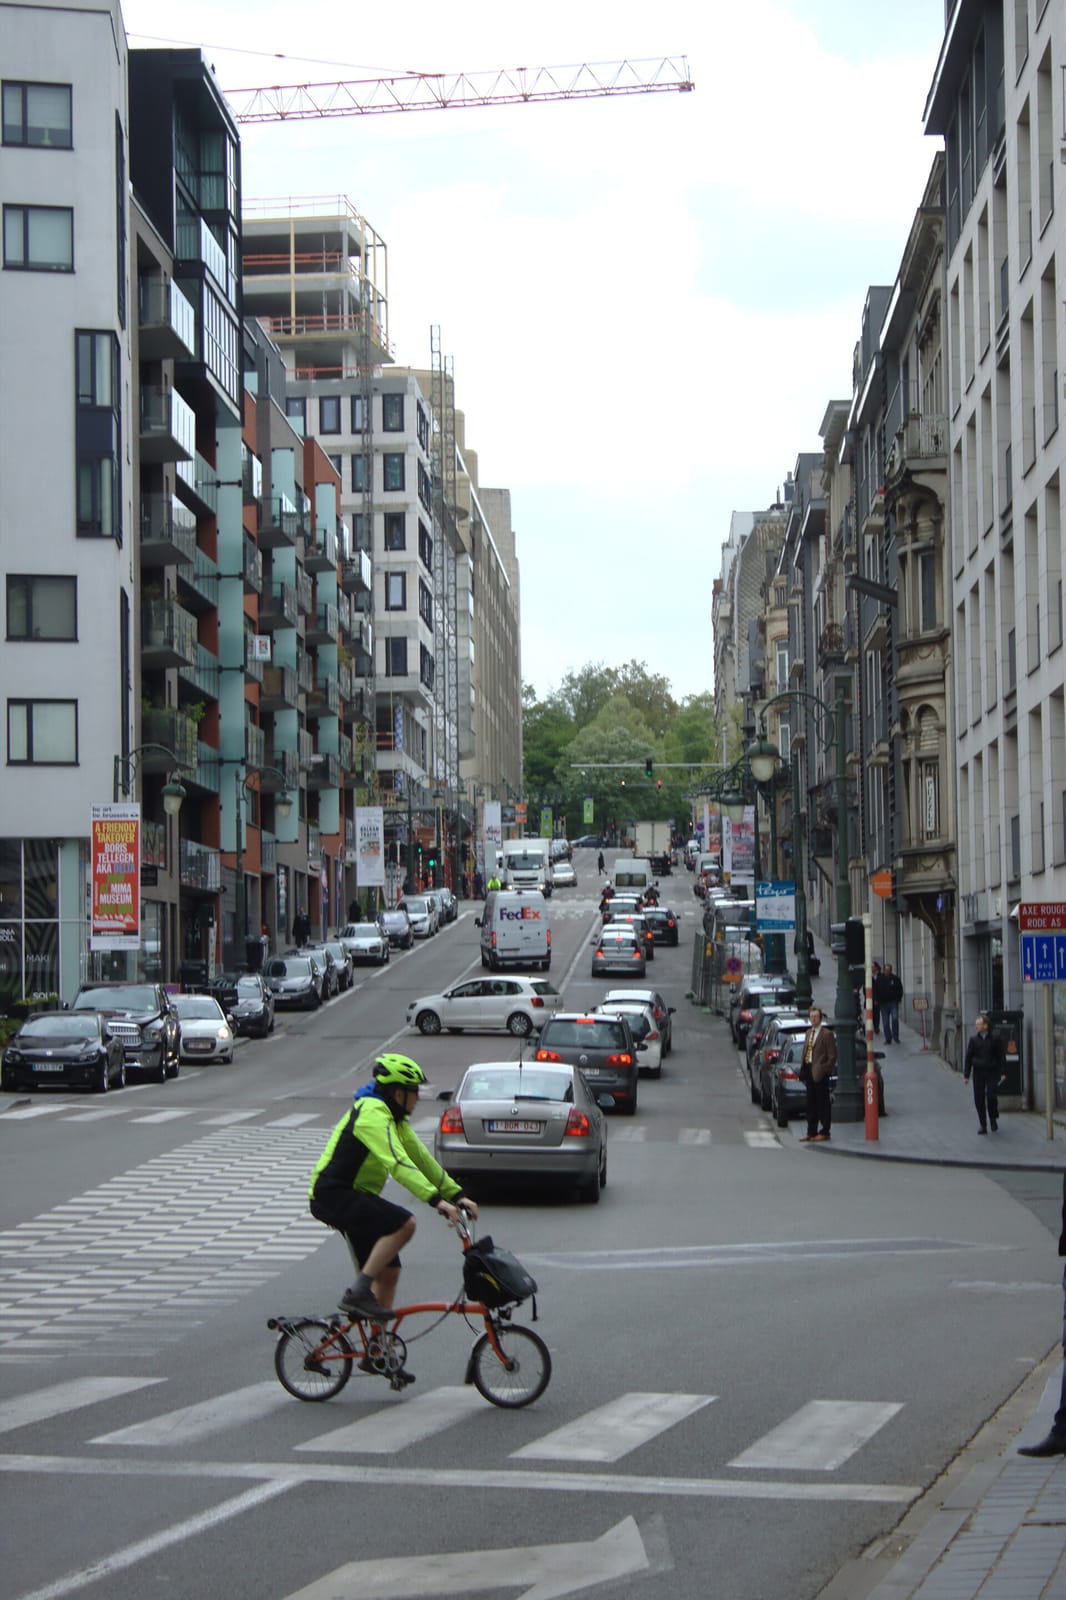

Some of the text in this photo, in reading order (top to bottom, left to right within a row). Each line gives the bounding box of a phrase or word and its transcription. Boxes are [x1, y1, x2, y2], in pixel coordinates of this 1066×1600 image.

[96, 822, 136, 832] A FRIENDLY
[97, 832, 135, 842] TAKEOVER
[105, 843, 127, 853] BORIS
[98, 853, 134, 863] TELLEGEN
[97, 863, 112, 873] AKA
[111, 884, 131, 893] MIMA
[100, 894, 132, 904] MUSEUM
[500, 906, 541, 921] FedEx
[1023, 904, 1066, 915] AXE ROUGE
[1027, 918, 1061, 928] RODE AS
[26, 954, 49, 962] MAKI
